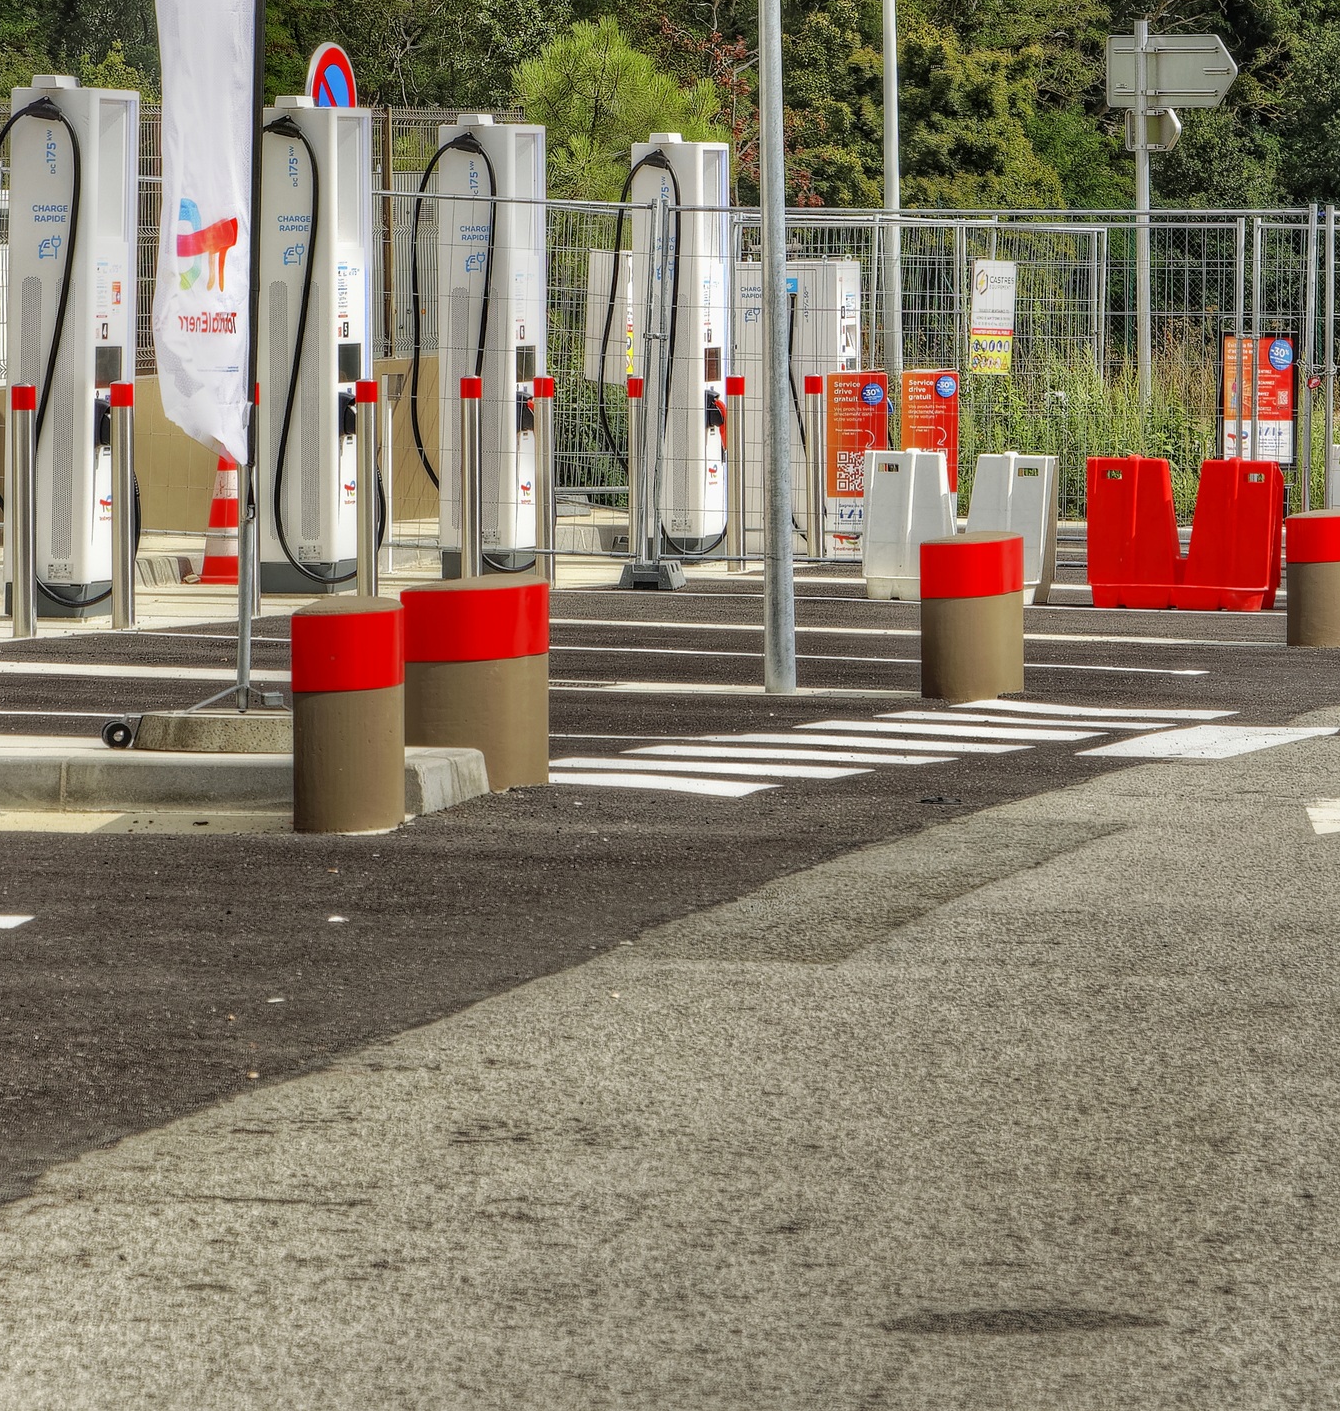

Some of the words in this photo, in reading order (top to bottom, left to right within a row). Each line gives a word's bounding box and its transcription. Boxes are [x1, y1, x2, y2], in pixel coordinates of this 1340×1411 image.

[46, 142, 56, 163] 175
[289, 157, 298, 177] 175
[469, 171, 478, 189] 175
[989, 276, 1014, 285] CASTRES
[1271, 346, 1289, 358] -30%
[863, 388, 881, 396] -30%
